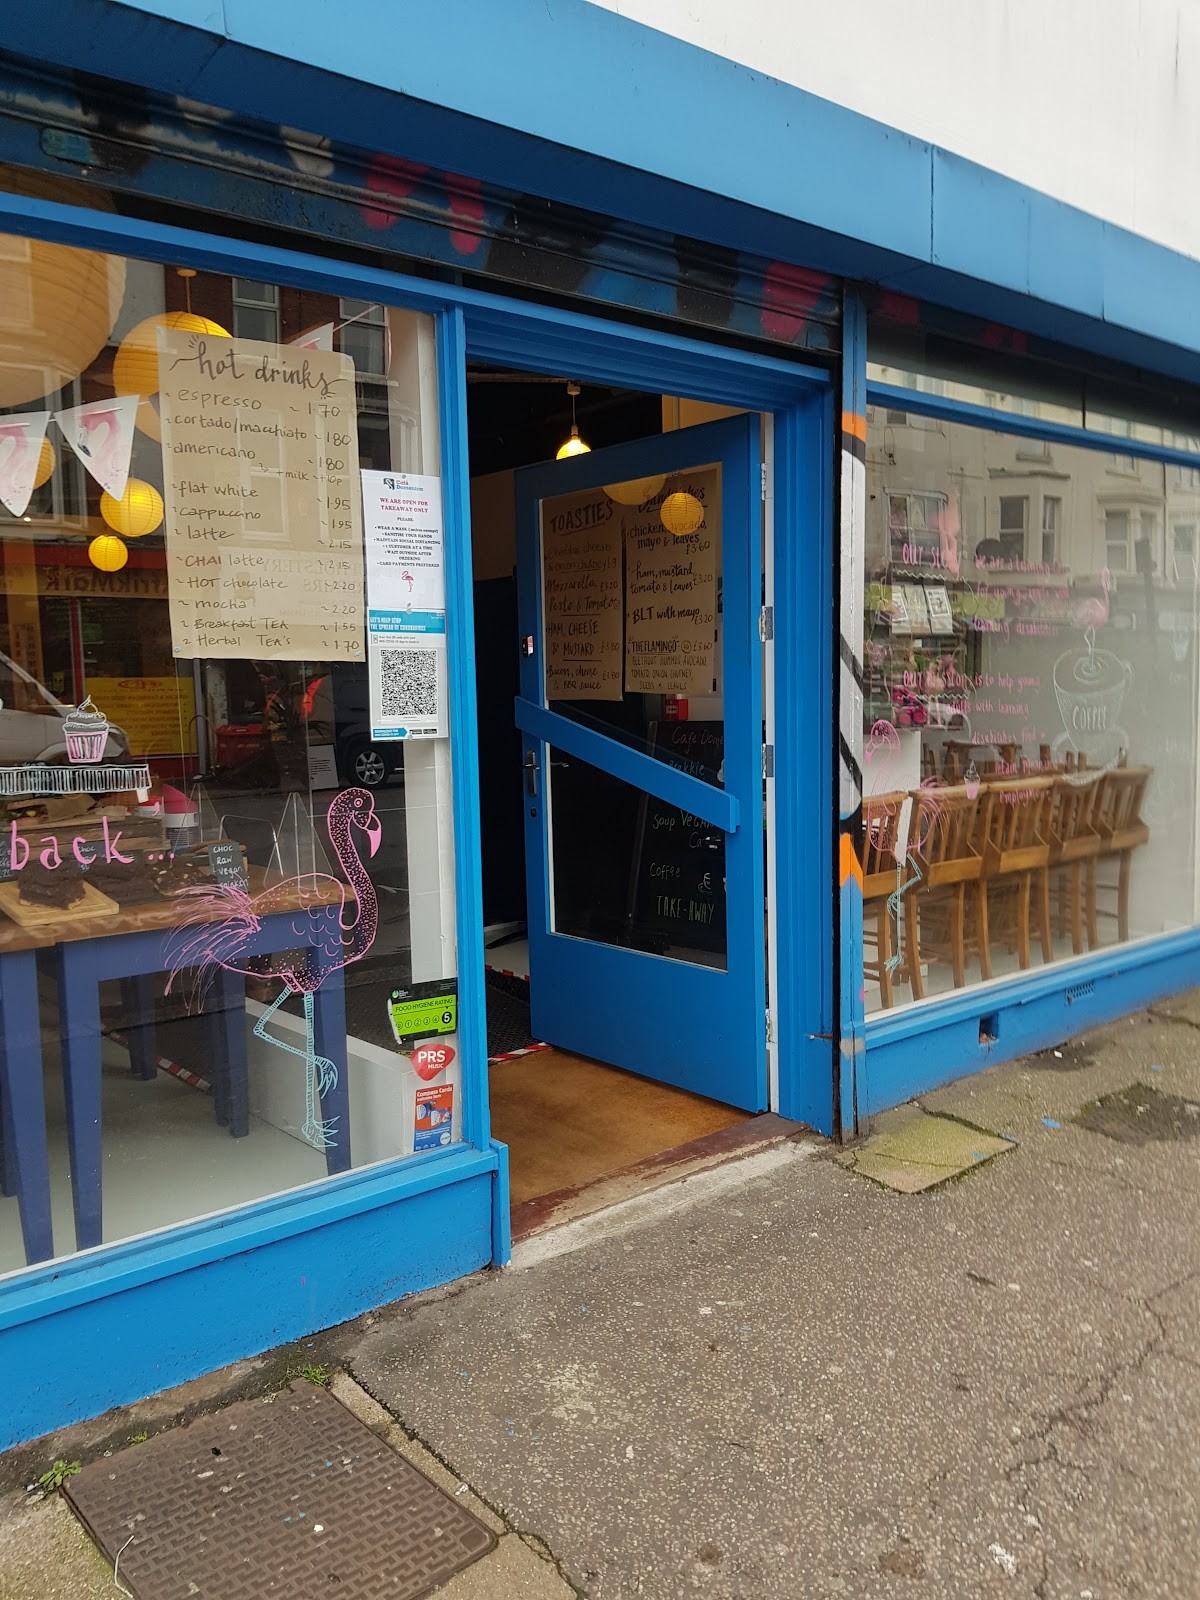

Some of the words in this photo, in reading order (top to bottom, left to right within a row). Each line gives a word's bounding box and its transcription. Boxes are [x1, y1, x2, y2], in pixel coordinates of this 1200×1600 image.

[190, 341, 244, 380] hot
[255, 355, 339, 397] drinks
[178, 388, 262, 410] espresso
[308, 402, 341, 419] 1.70
[174, 414, 307, 440] cortado/macchiato
[327, 431, 352, 447] 1.80
[173, 442, 256, 461] americano
[319, 456, 345, 471] 1.80
[285, 469, 309, 481] milk
[178, 481, 209, 498] flat
[214, 482, 259, 498] white
[327, 497, 351, 511] 1.95
[180, 507, 261, 520] cappuccino
[332, 519, 352, 530] 1.95
[551, 499, 613, 533] TOASTIES
[188, 525, 234, 540] latte
[329, 539, 352, 549] 2.15
[637, 535, 661, 552] mayo
[672, 533, 700, 546] leaves
[185, 555, 222, 567] CHAI
[228, 554, 265, 566] latte
[328, 560, 351, 570] 2.15
[187, 577, 222, 589] HOT
[223, 578, 289, 590] chocolate
[332, 582, 356, 592] 2.20
[629, 580, 661, 595] tomato
[670, 579, 693, 594] leaves
[195, 600, 247, 610] mocha
[332, 605, 357, 615] 2.20
[632, 606, 654, 624] BLT
[656, 606, 676, 620] with
[677, 608, 700, 622] mayo
[194, 616, 257, 631] Breakfast
[334, 622, 357, 632] 1.55
[568, 619, 599, 637] CHEESE
[197, 635, 242, 647] Herbal
[335, 640, 360, 652] 1.70
[563, 642, 594, 656] MUSTARD
[986, 673, 994, 686] to
[997, 672, 1014, 693] help
[976, 699, 994, 714] with
[672, 726, 698, 752] Cafe
[653, 814, 676, 831] Soup
[213, 845, 234, 854] CHOC
[650, 862, 681, 880] Coffee
[395, 1004, 412, 1012] FOOD
[412, 1000, 434, 1010] HYGIENE
[434, 998, 453, 1006] RATING
[418, 1049, 446, 1064] PRS
[439, 1085, 452, 1094] Cards
